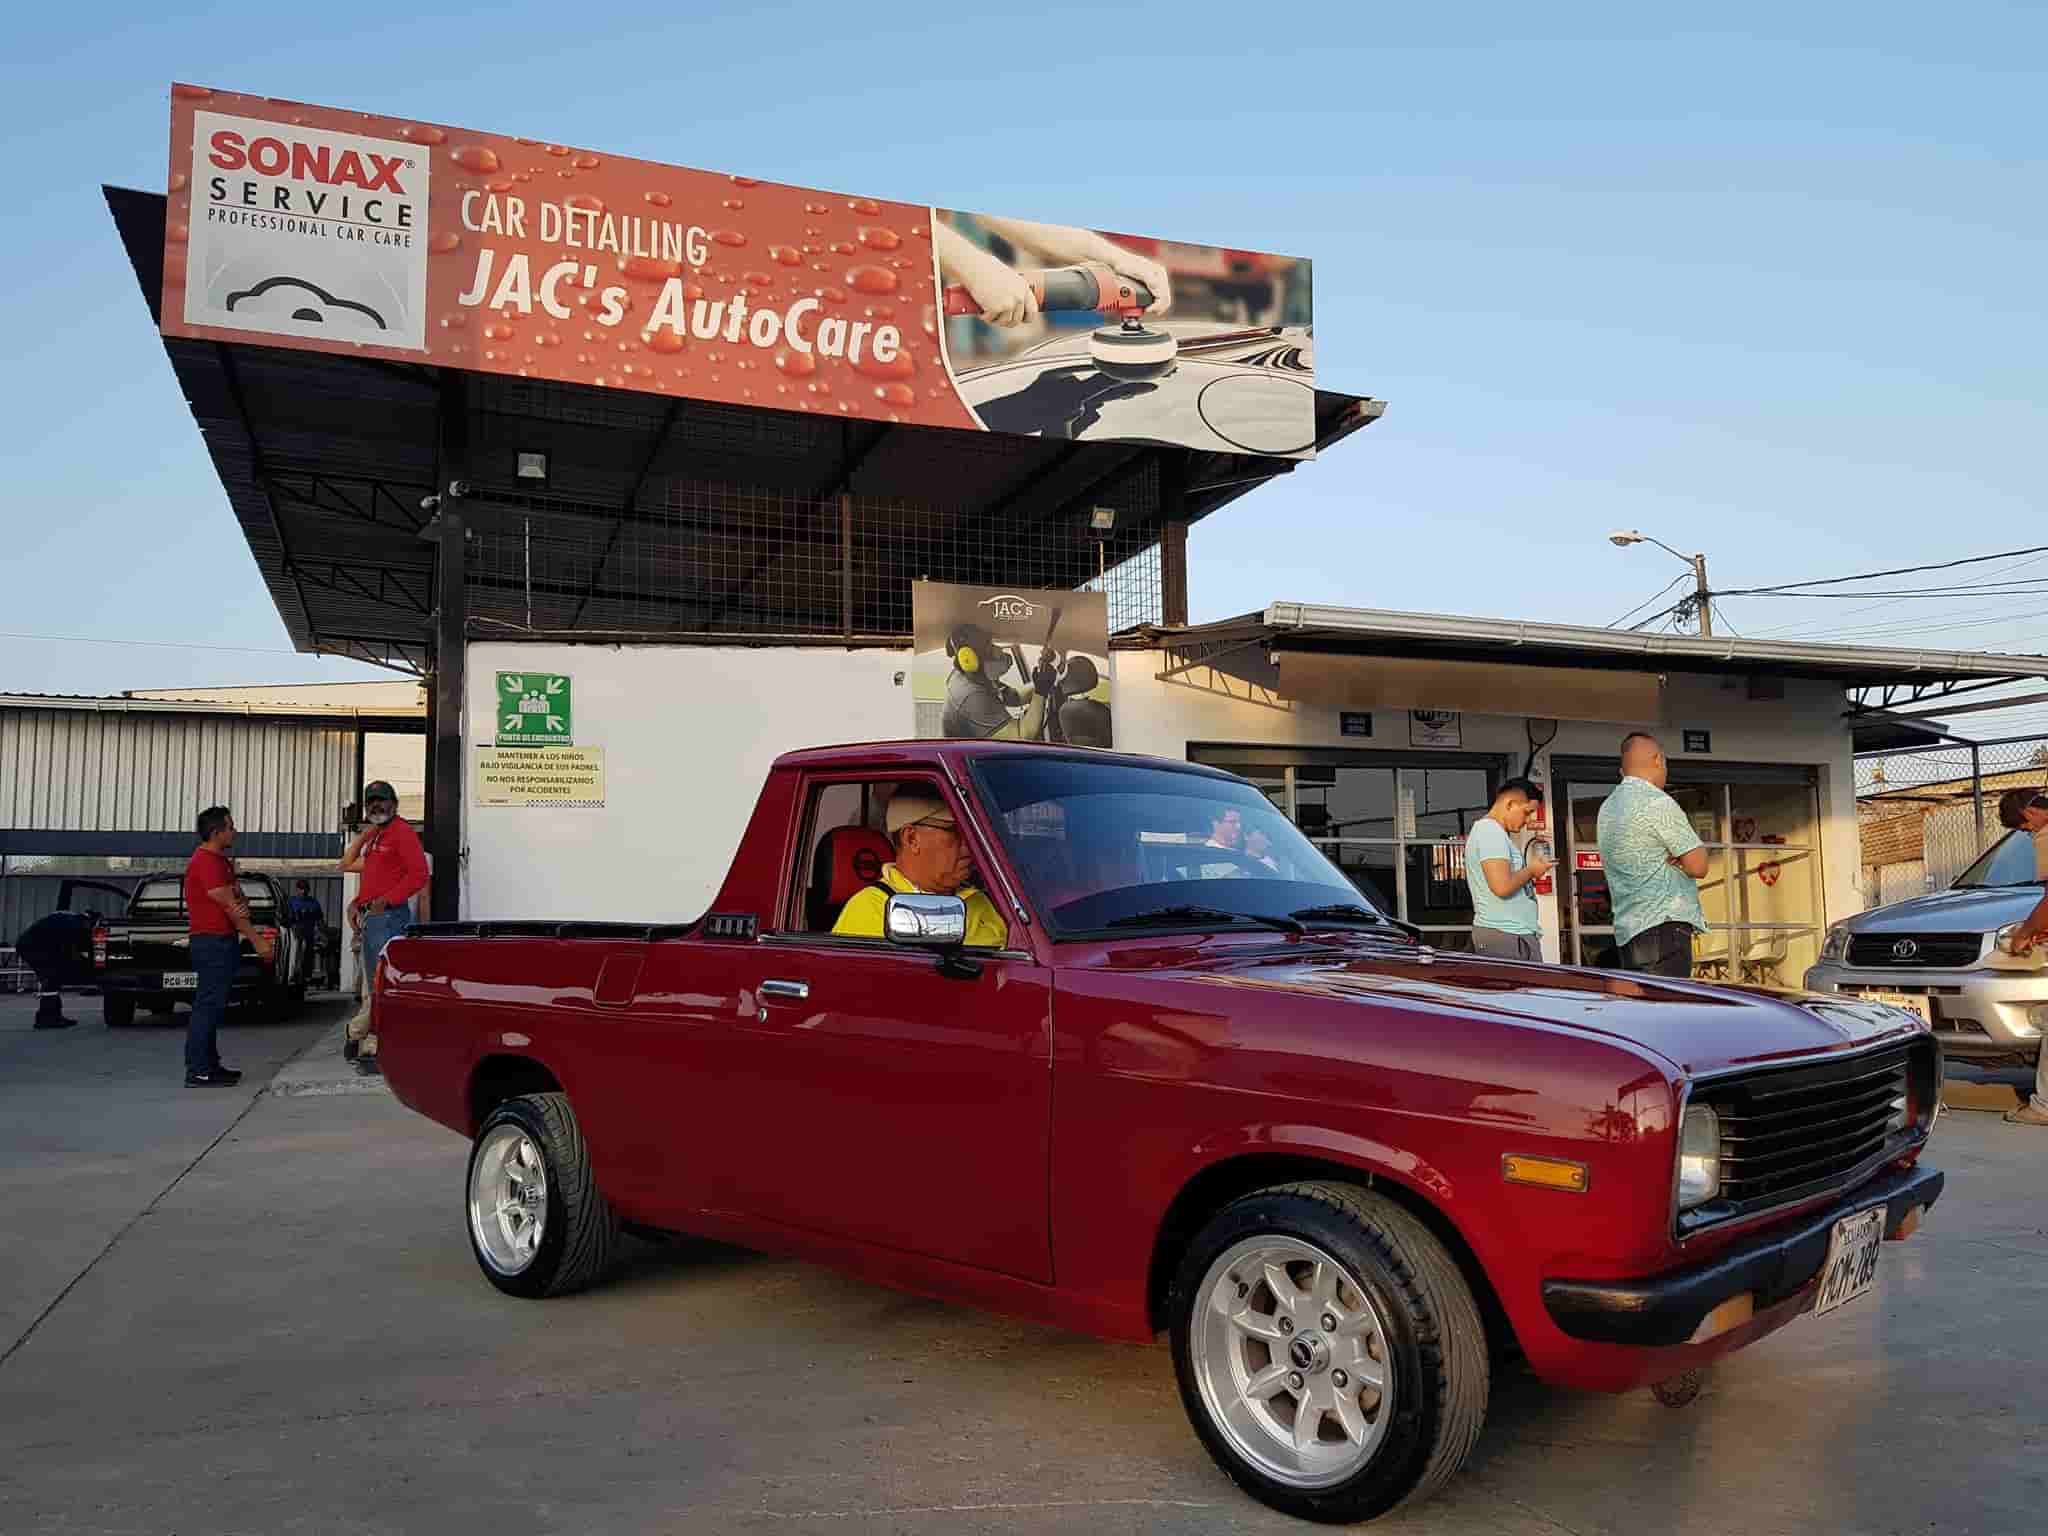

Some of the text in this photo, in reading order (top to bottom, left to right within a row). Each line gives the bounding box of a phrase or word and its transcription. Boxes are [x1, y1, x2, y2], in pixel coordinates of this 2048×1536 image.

[209, 131, 406, 195] SONAX
[209, 177, 412, 228] SERVICE
[207, 208, 412, 249] PROFESSIONAL CAR CARE
[460, 190, 708, 267] CAR DETAILING
[457, 248, 901, 364] JAC's AutoCare
[497, 751, 538, 760] MANTENER
[546, 753, 560, 761] LOS
[501, 762, 542, 770] VIGILANCIA
[486, 775, 498, 783] NO
[516, 776, 595, 784] RESPONSABILIZAMOS
